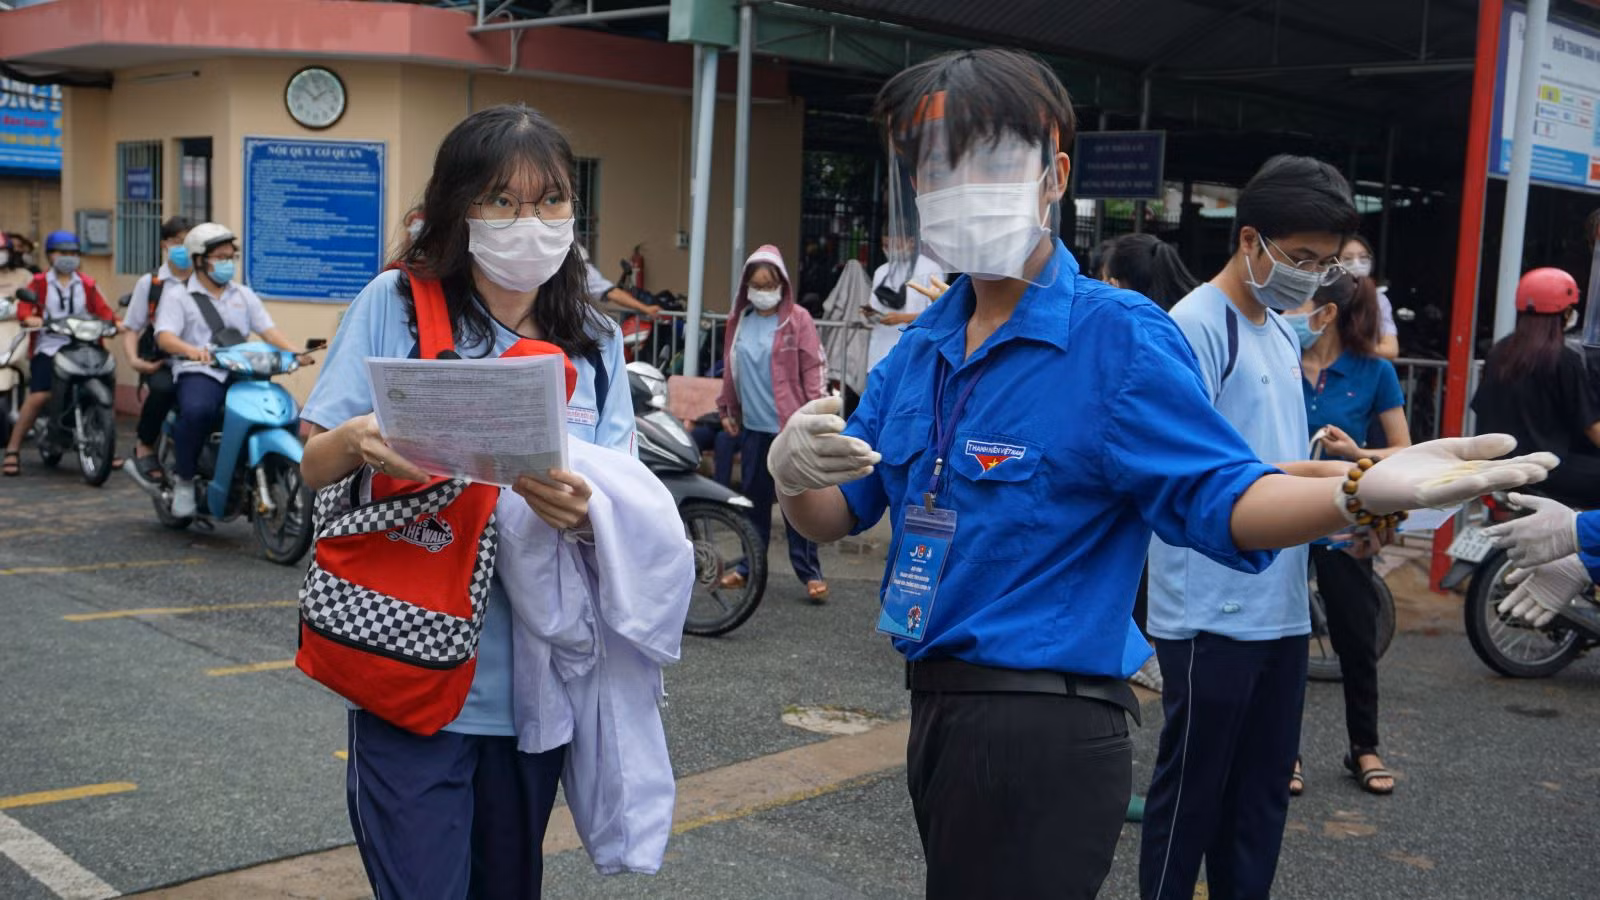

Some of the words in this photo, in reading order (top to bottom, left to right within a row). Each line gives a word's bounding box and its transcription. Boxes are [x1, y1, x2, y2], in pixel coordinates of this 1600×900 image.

[268, 145, 288, 156] NỘI
[290, 147, 312, 159] QUY
[332, 149, 362, 160] QUAN
[421, 528, 447, 543] WALL
